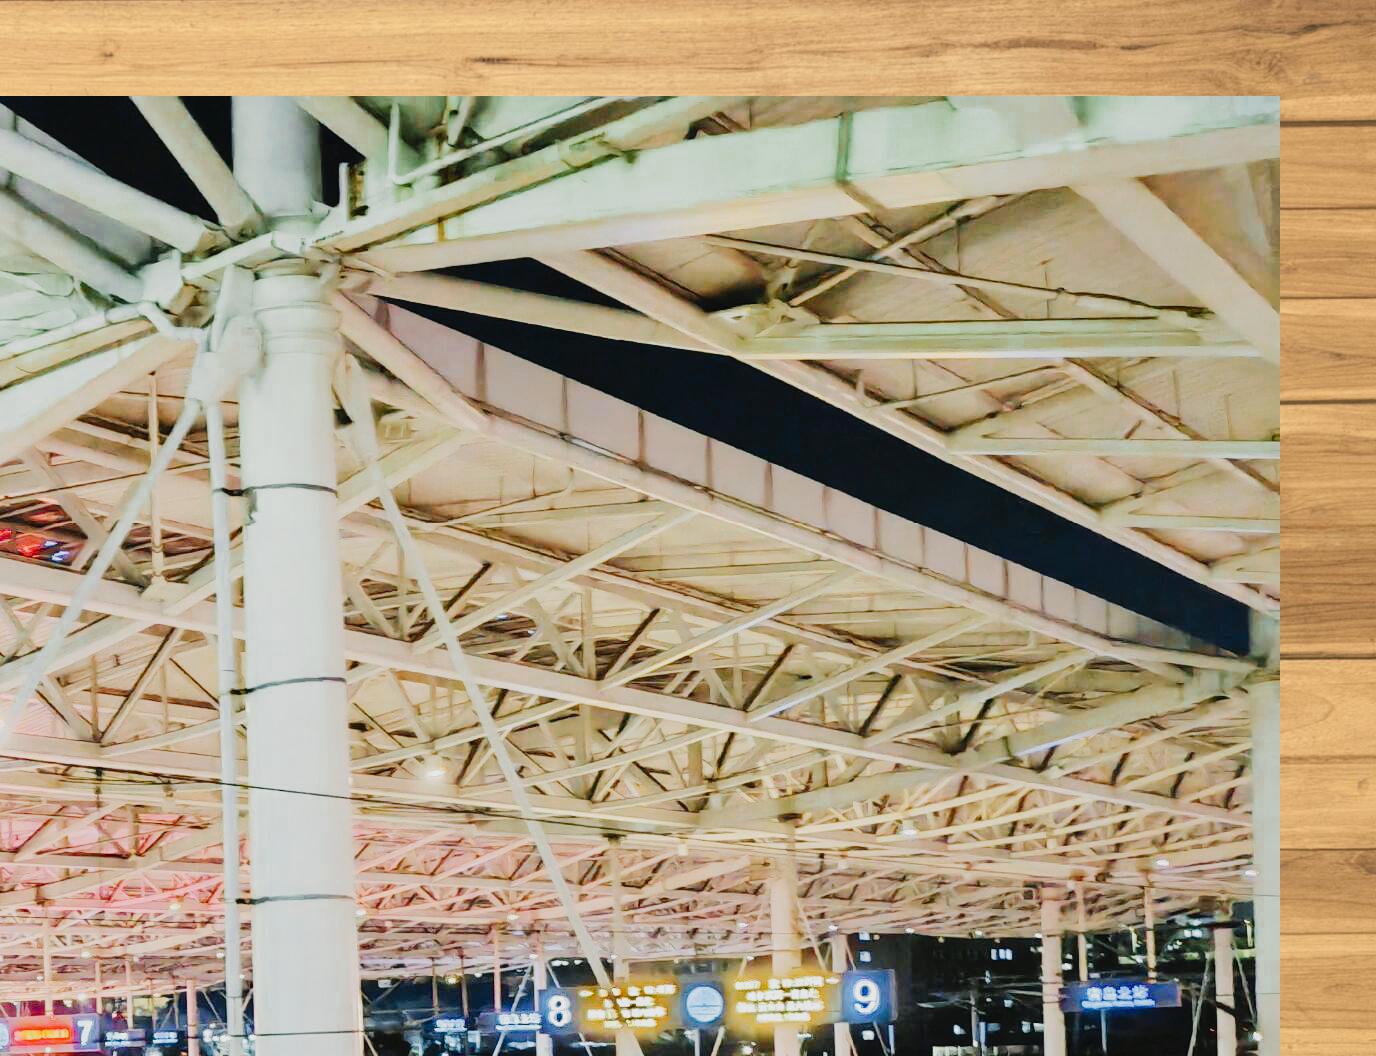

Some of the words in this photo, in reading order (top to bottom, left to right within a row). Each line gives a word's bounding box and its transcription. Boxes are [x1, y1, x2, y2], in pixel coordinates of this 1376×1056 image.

[547, 995, 572, 1027] 8
[853, 978, 880, 1015] 9
[77, 1020, 94, 1047] 7
